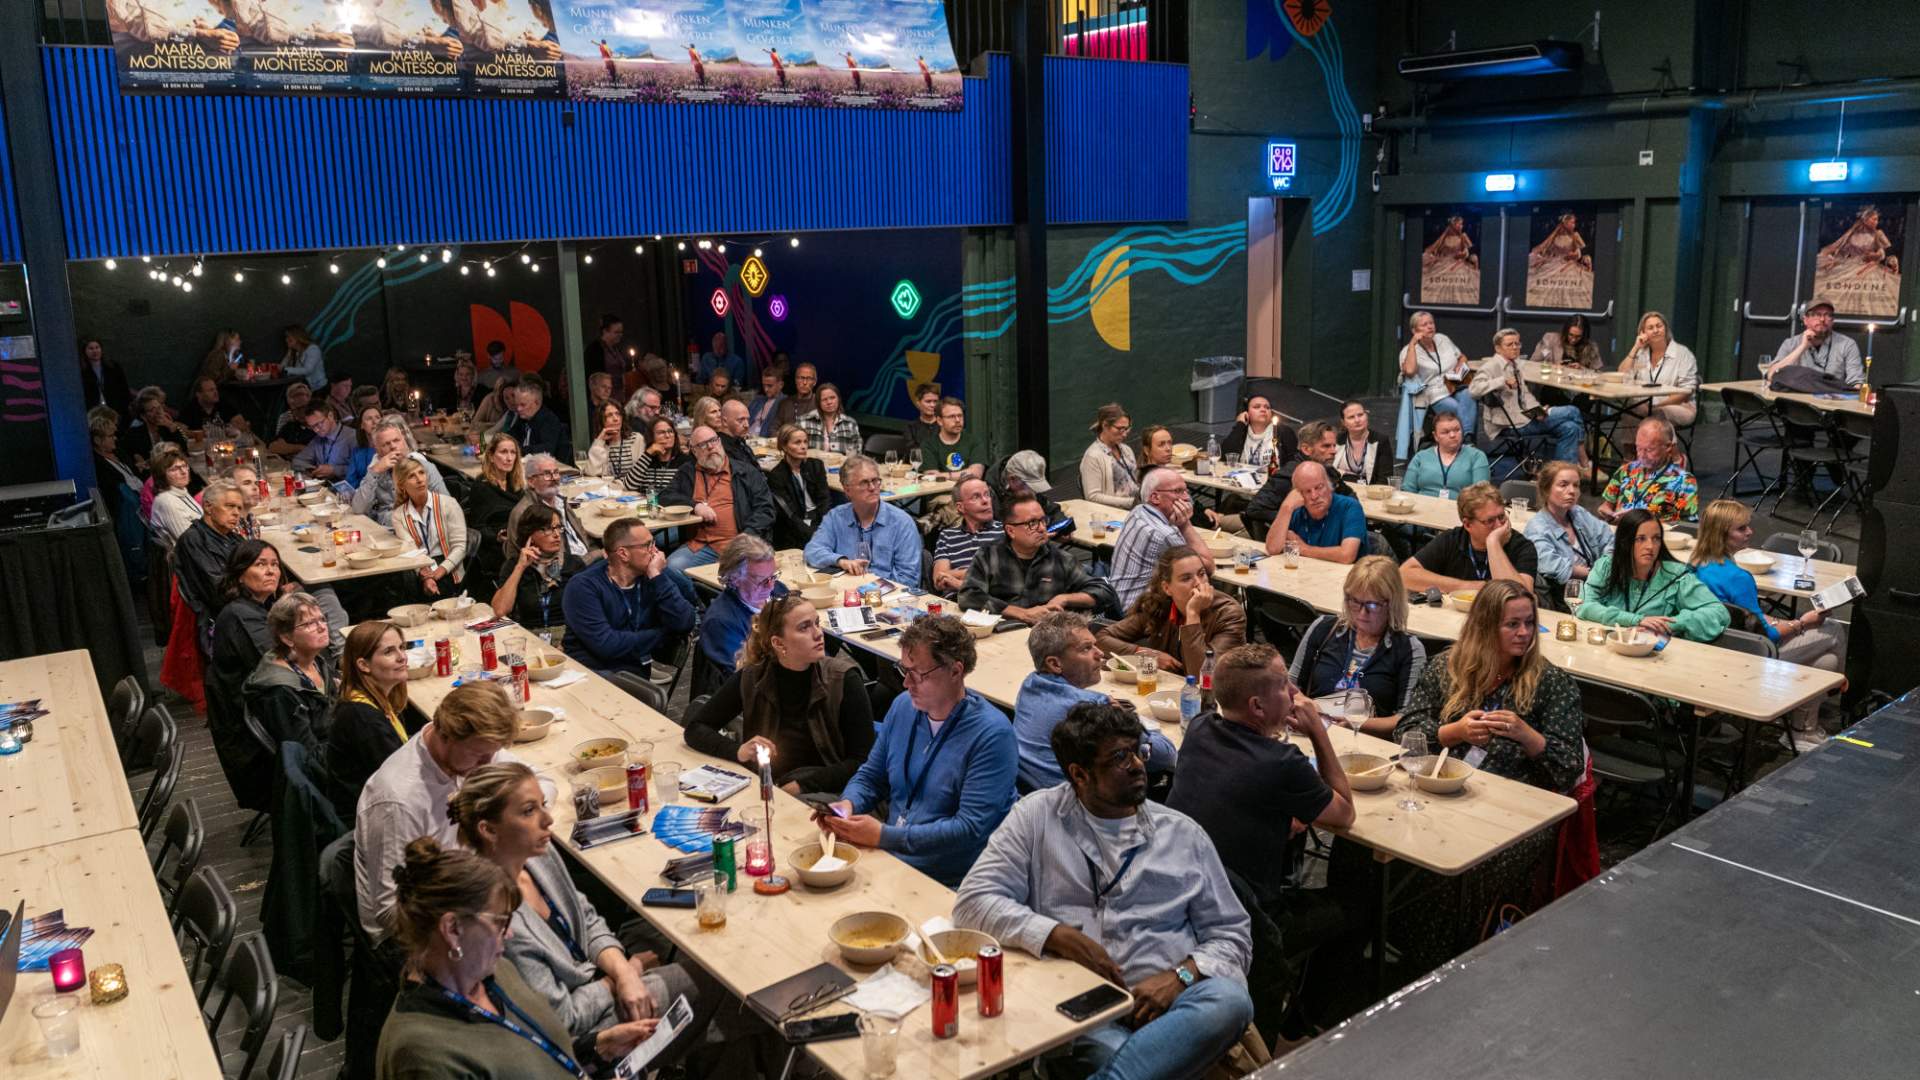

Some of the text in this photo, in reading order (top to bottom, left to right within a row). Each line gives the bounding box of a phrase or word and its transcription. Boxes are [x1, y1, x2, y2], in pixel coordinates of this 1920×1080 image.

[743, 16, 791, 30] MUNKEN
[154, 43, 206, 56] MARIA
[276, 46, 324, 59] MARIA
[391, 50, 435, 62] MARIA
[129, 55, 232, 70] MONTESSORI
[253, 57, 349, 72] MONTESSORI
[494, 53, 536, 65] MARIA
[369, 61, 457, 75] MONTESSORI
[475, 63, 557, 78] MONTESSORI
[1272, 177, 1290, 190] WC
[1826, 282, 1888, 291] BØNDENE
